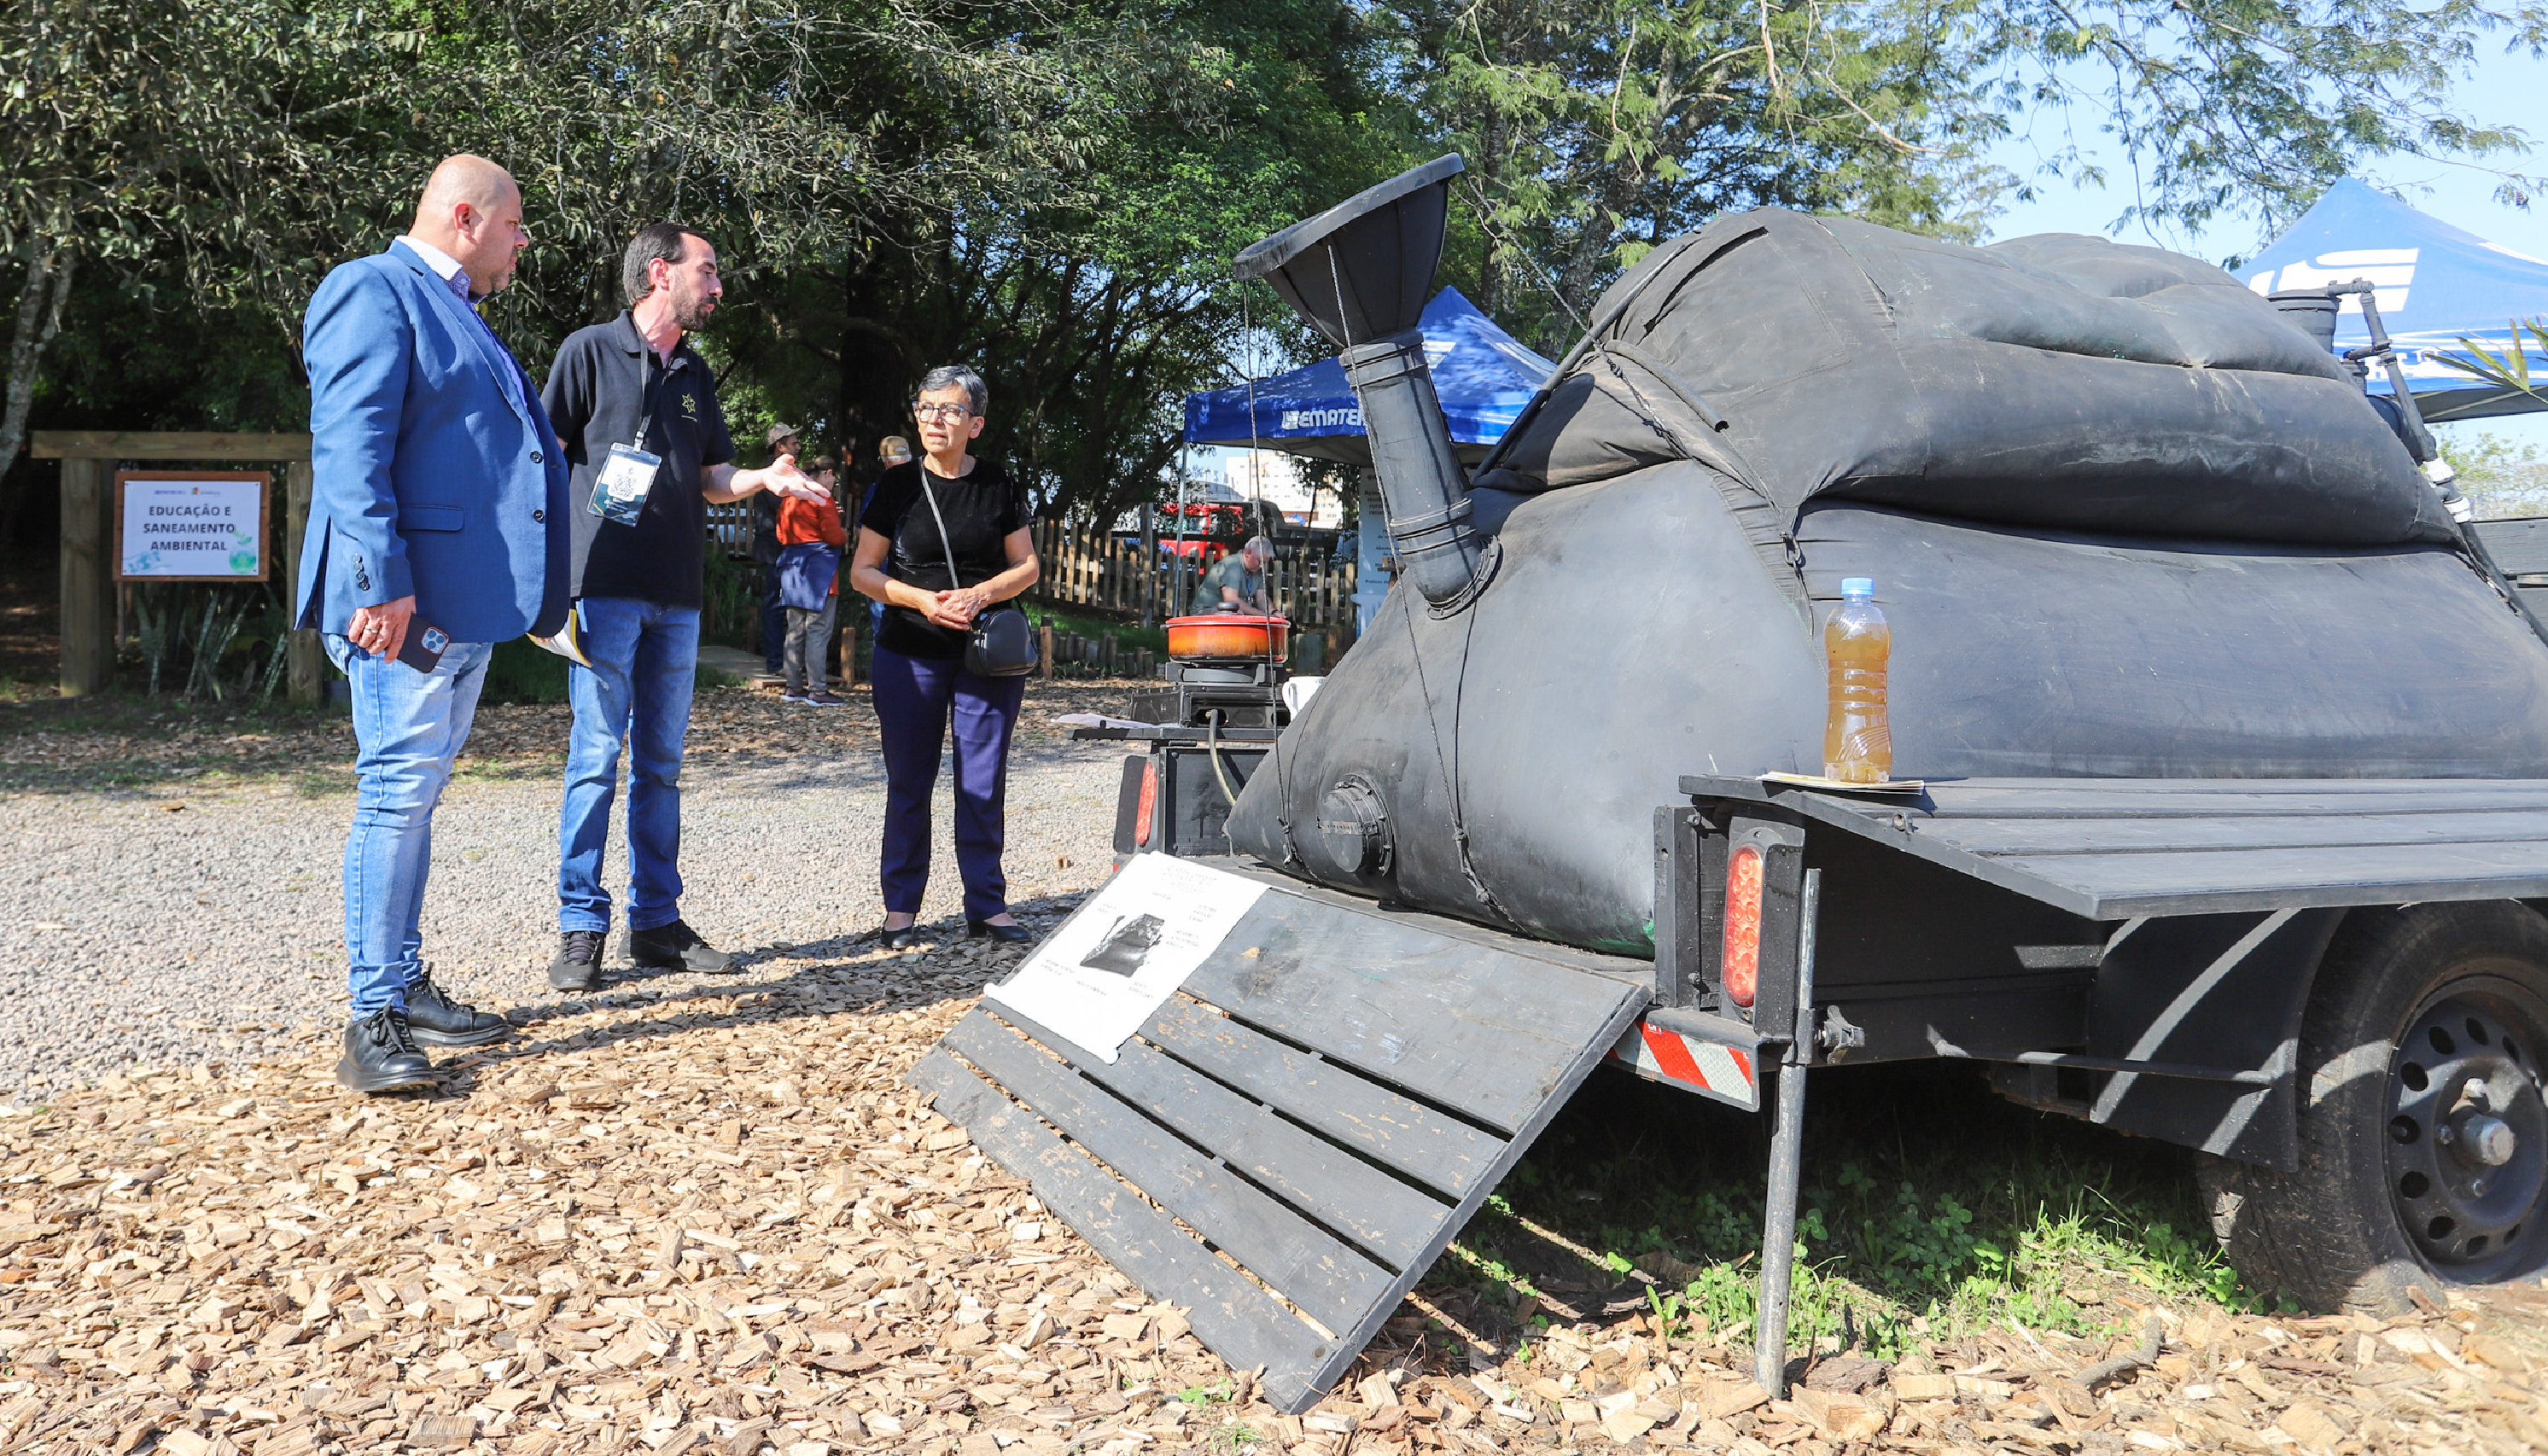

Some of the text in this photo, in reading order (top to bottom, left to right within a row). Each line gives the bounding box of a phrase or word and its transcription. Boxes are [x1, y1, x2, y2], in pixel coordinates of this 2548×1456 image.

[149, 504, 231, 518] EDUCAÇÃO E
[143, 523, 236, 534] SANEAMENTO
[150, 541, 227, 550] AMBIENTAL
